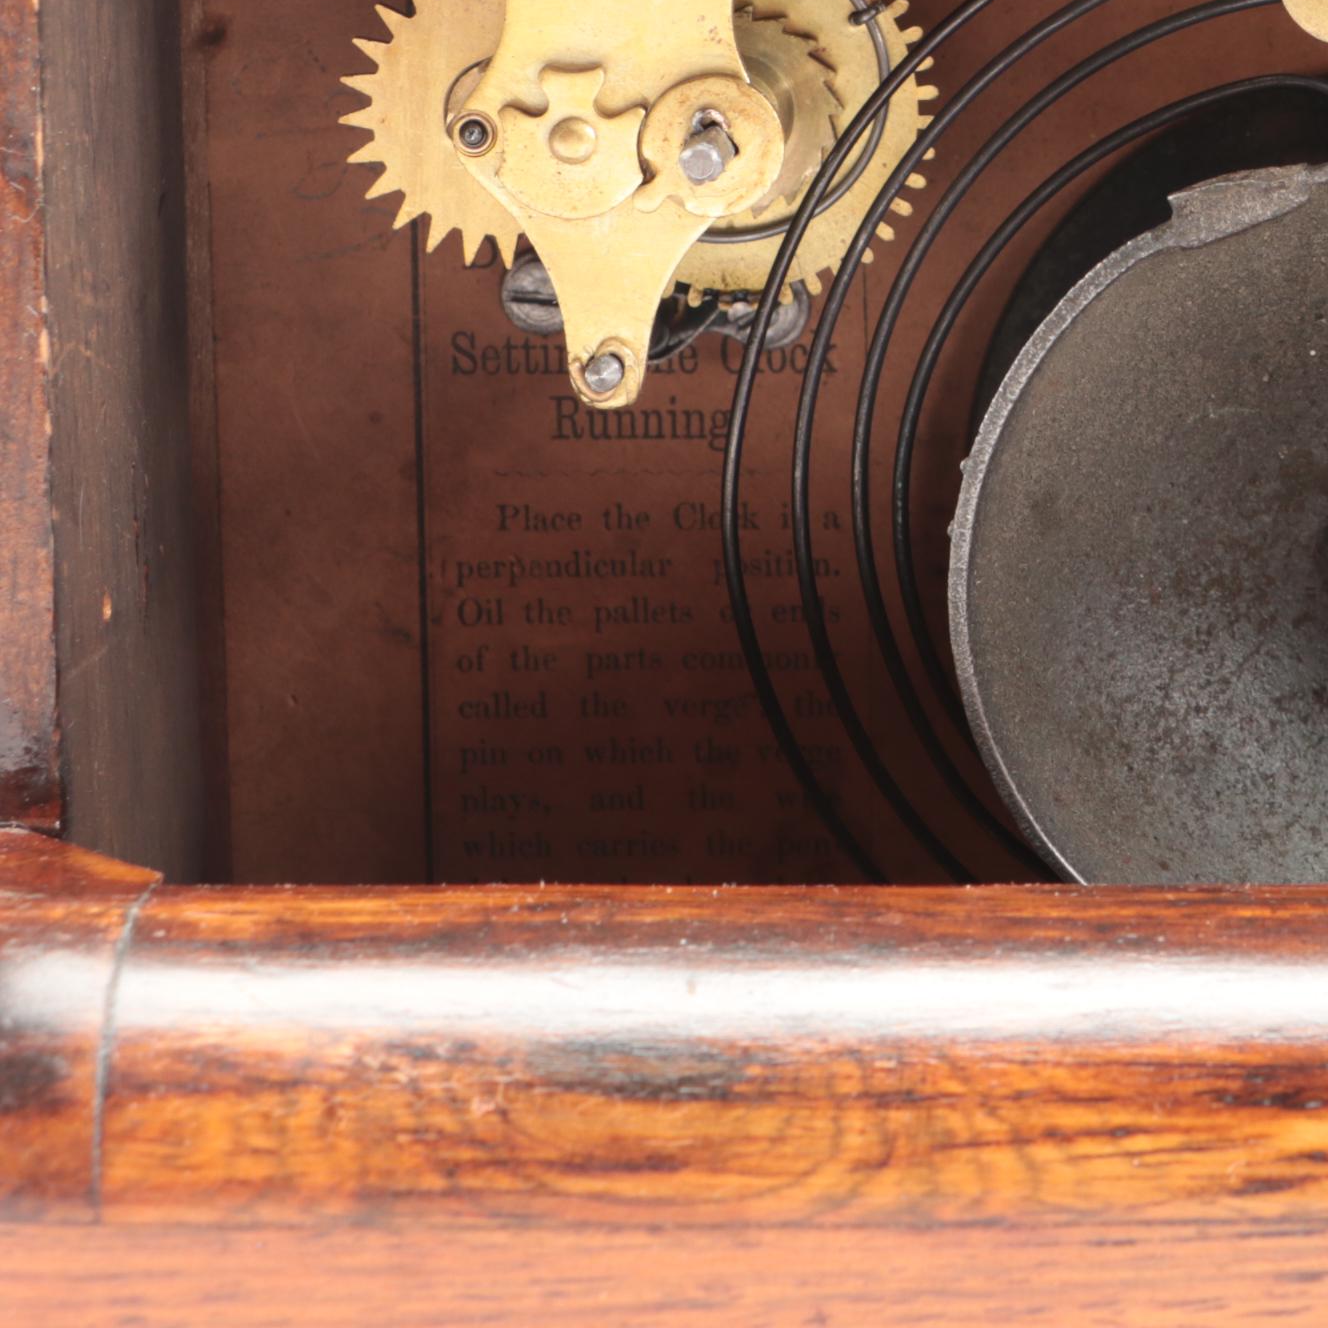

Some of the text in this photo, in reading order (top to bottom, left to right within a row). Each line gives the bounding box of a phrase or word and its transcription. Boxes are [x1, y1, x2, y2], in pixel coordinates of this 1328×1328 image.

[549, 394, 736, 452] Running
[496, 503, 582, 531] Place
[602, 500, 651, 531] the
[455, 549, 672, 588] perpendicular
[457, 596, 504, 627] Oil
[524, 597, 572, 626] the
[594, 595, 694, 633] pallets
[455, 645, 489, 673] of
[510, 645, 558, 672] the
[585, 648, 663, 680] parts
[458, 690, 549, 720] called
[580, 691, 628, 719] the
[460, 737, 508, 774] pin
[527, 744, 565, 766] on
[585, 735, 673, 765] which
[589, 784, 646, 812] and
[462, 830, 554, 858] which
[576, 828, 682, 859] carries
